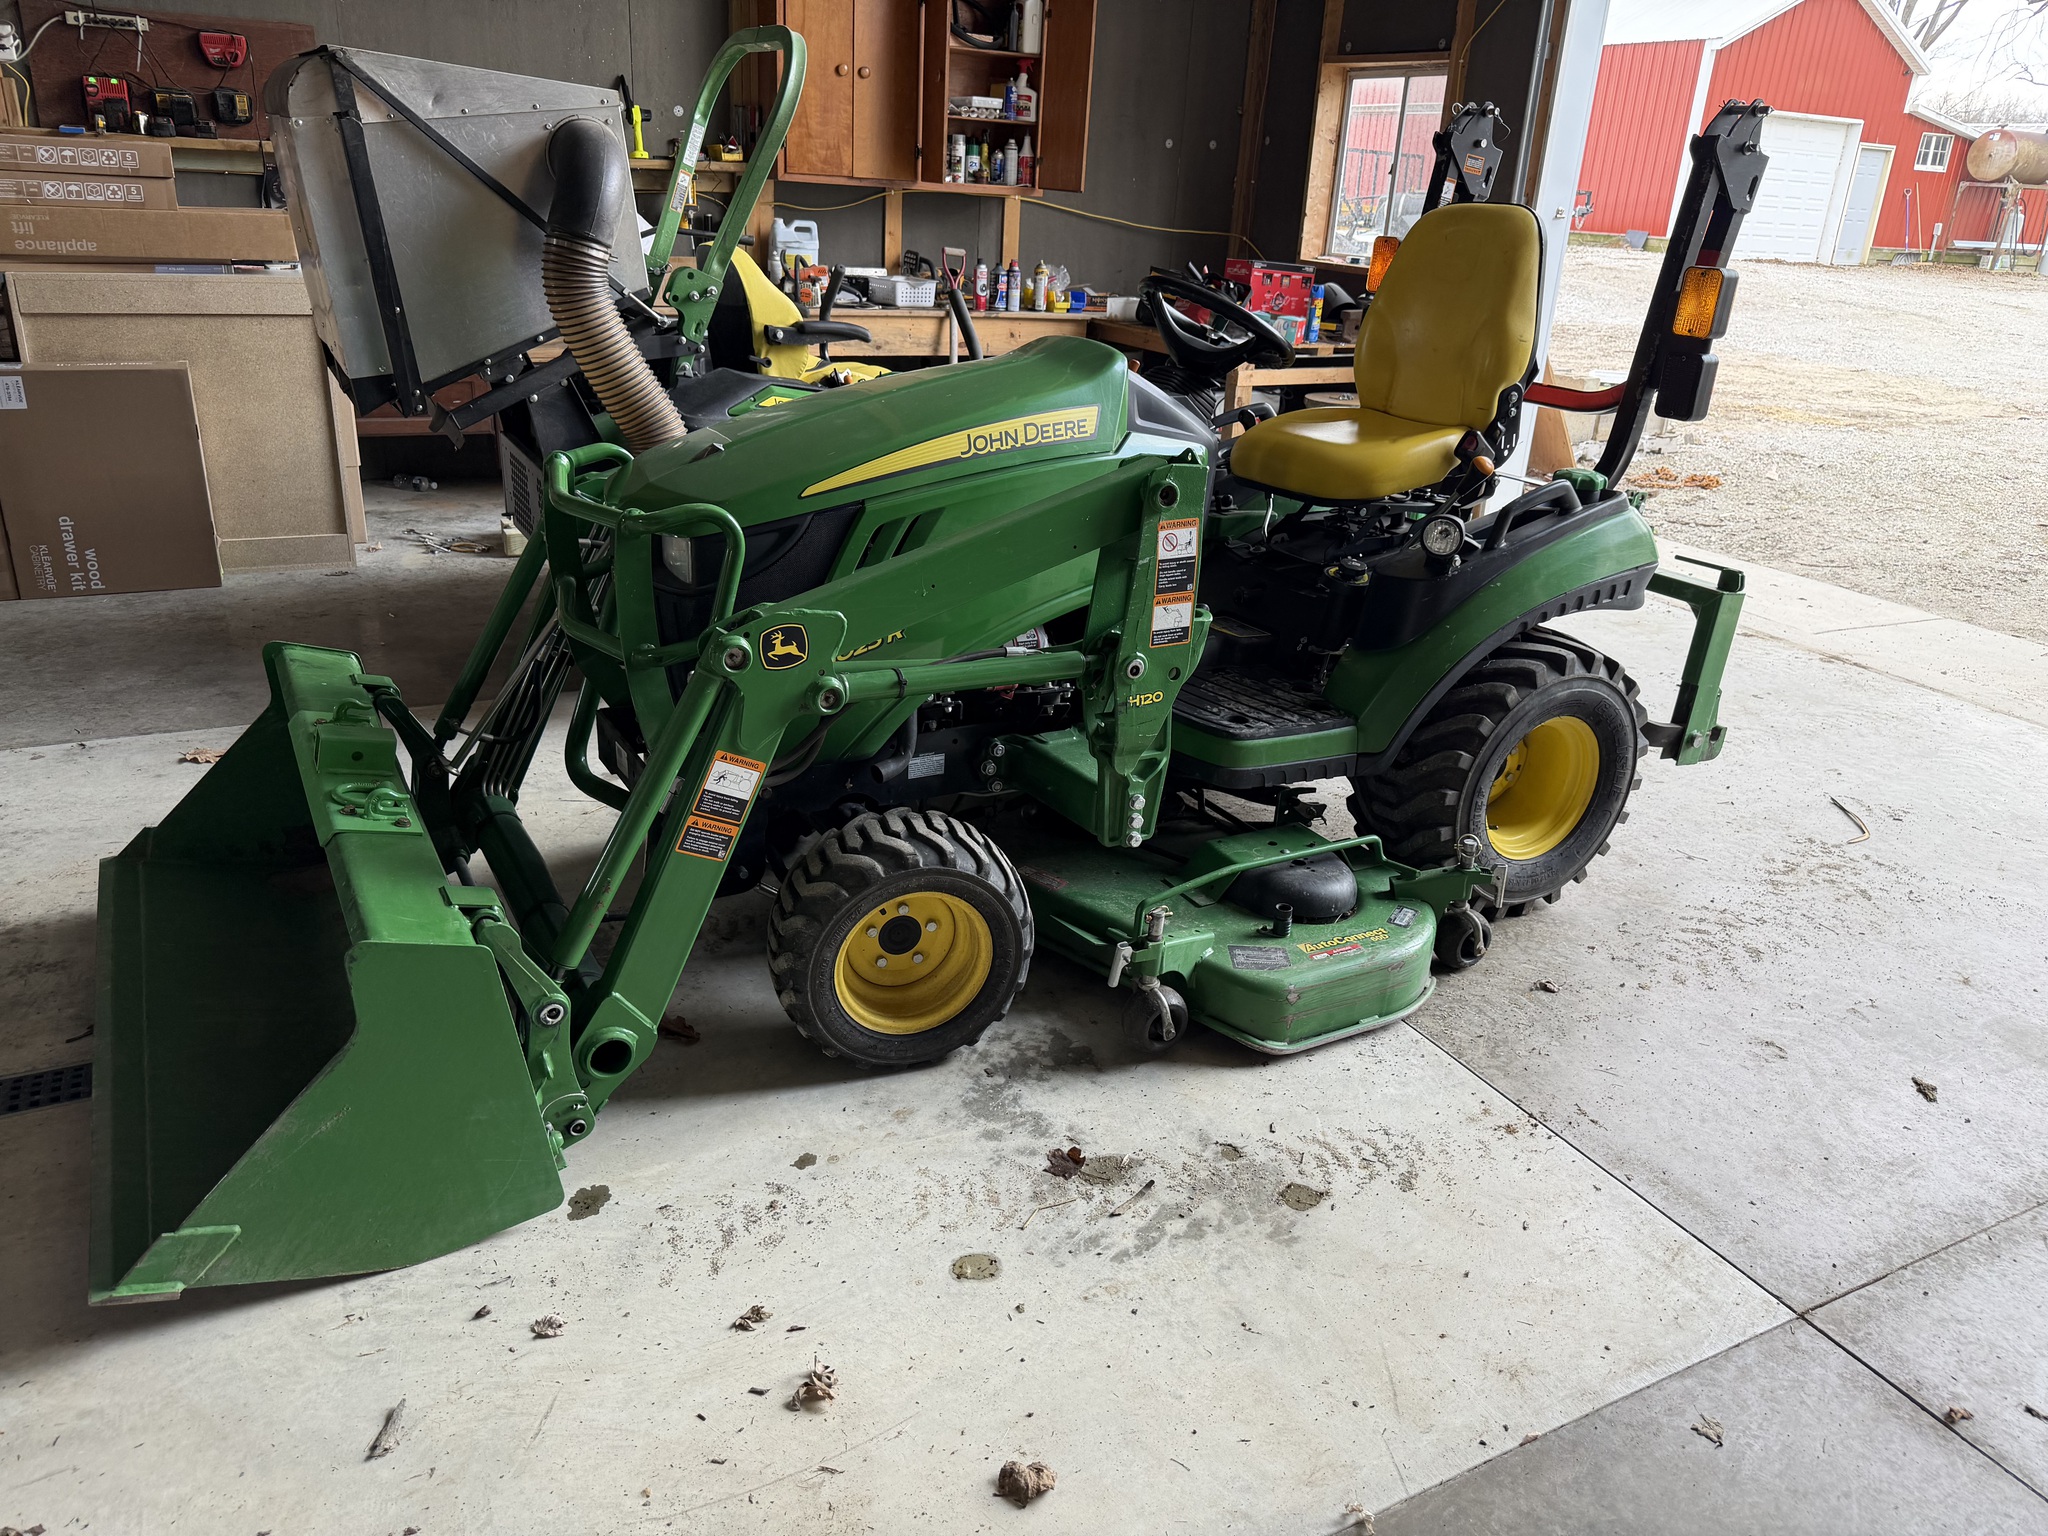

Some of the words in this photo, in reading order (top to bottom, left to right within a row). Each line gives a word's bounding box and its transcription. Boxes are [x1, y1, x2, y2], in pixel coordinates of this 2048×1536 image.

[126, 152, 132, 161] 5
[131, 186, 137, 195] 5
[11, 221, 35, 235] lift
[14, 239, 97, 254] appliance
[960, 428, 1019, 456] JOHN
[1023, 418, 1088, 443] DEERE
[1165, 519, 1197, 528] WARNING
[58, 516, 80, 569] drawer
[69, 572, 87, 591] kit
[29, 545, 47, 591] CABINETRY
[84, 548, 106, 590] wood
[1161, 594, 1192, 604] WARNING
[1129, 691, 1164, 707] H120
[1595, 698, 1630, 800] CARLISLE
[729, 756, 760, 770] WARNING
[701, 821, 733, 834] WARNING
[1304, 927, 1388, 953] AutoConnect
